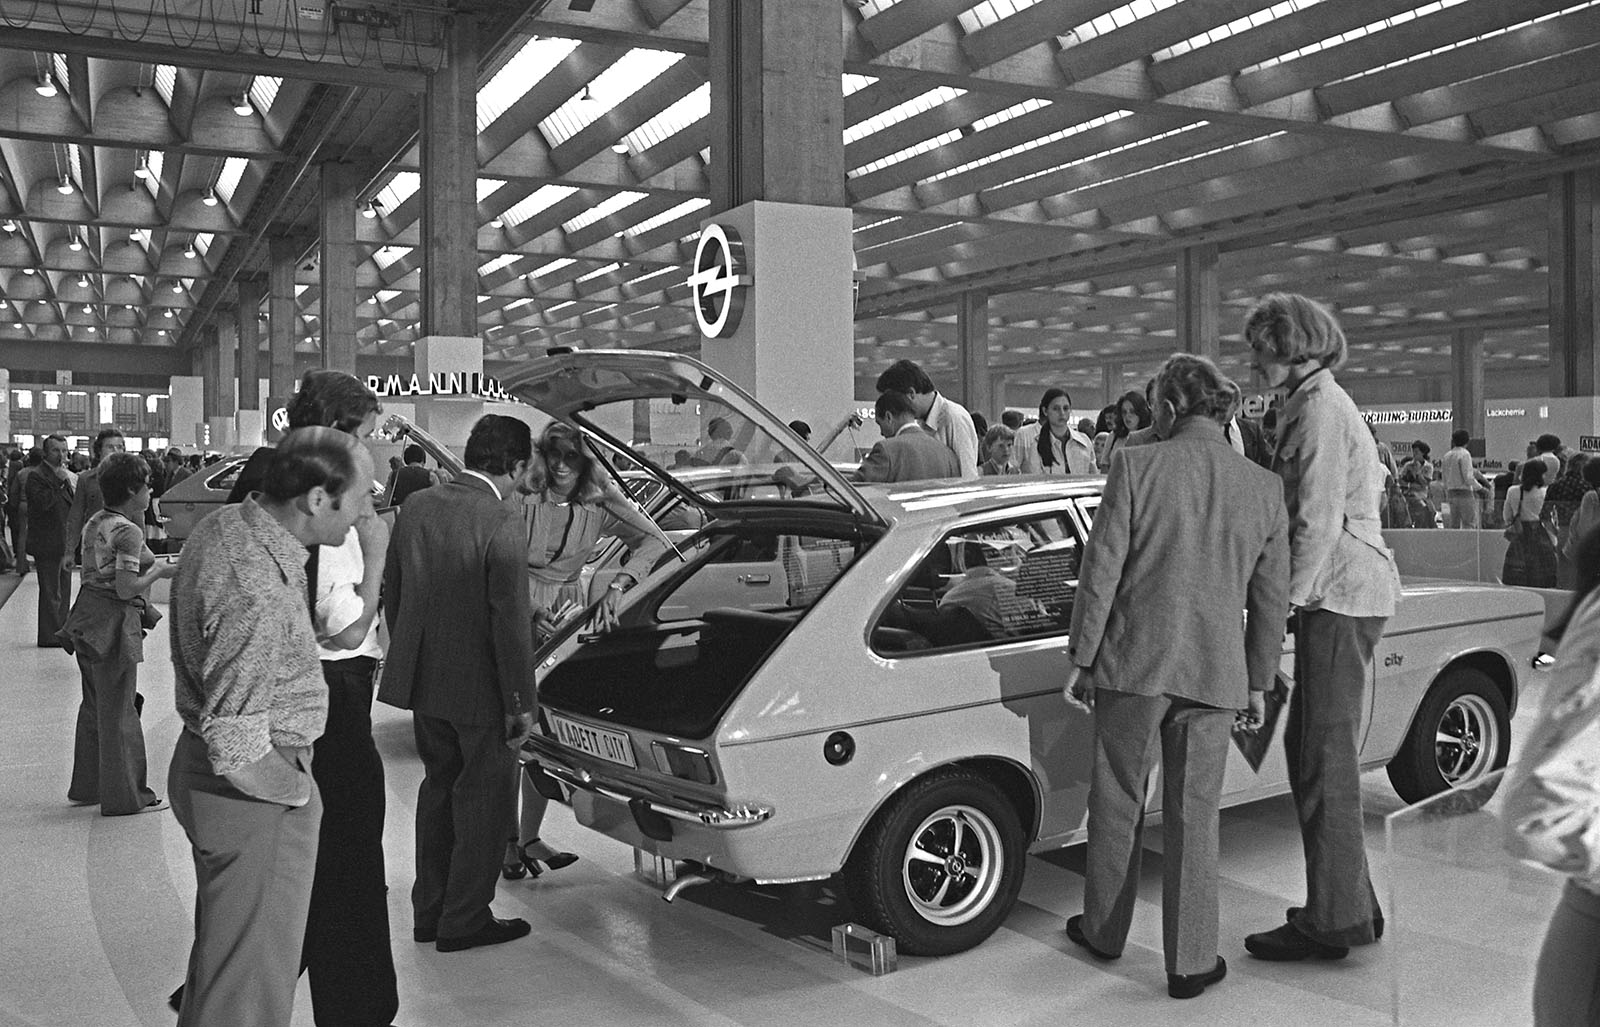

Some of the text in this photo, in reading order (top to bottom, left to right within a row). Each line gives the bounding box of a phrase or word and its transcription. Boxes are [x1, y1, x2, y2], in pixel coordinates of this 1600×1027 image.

[363, 372, 467, 397] RMANN
[1486, 408, 1526, 417] Lackchemie
[1384, 652, 1404, 667] city
[555, 718, 628, 762] KADETT CITY
